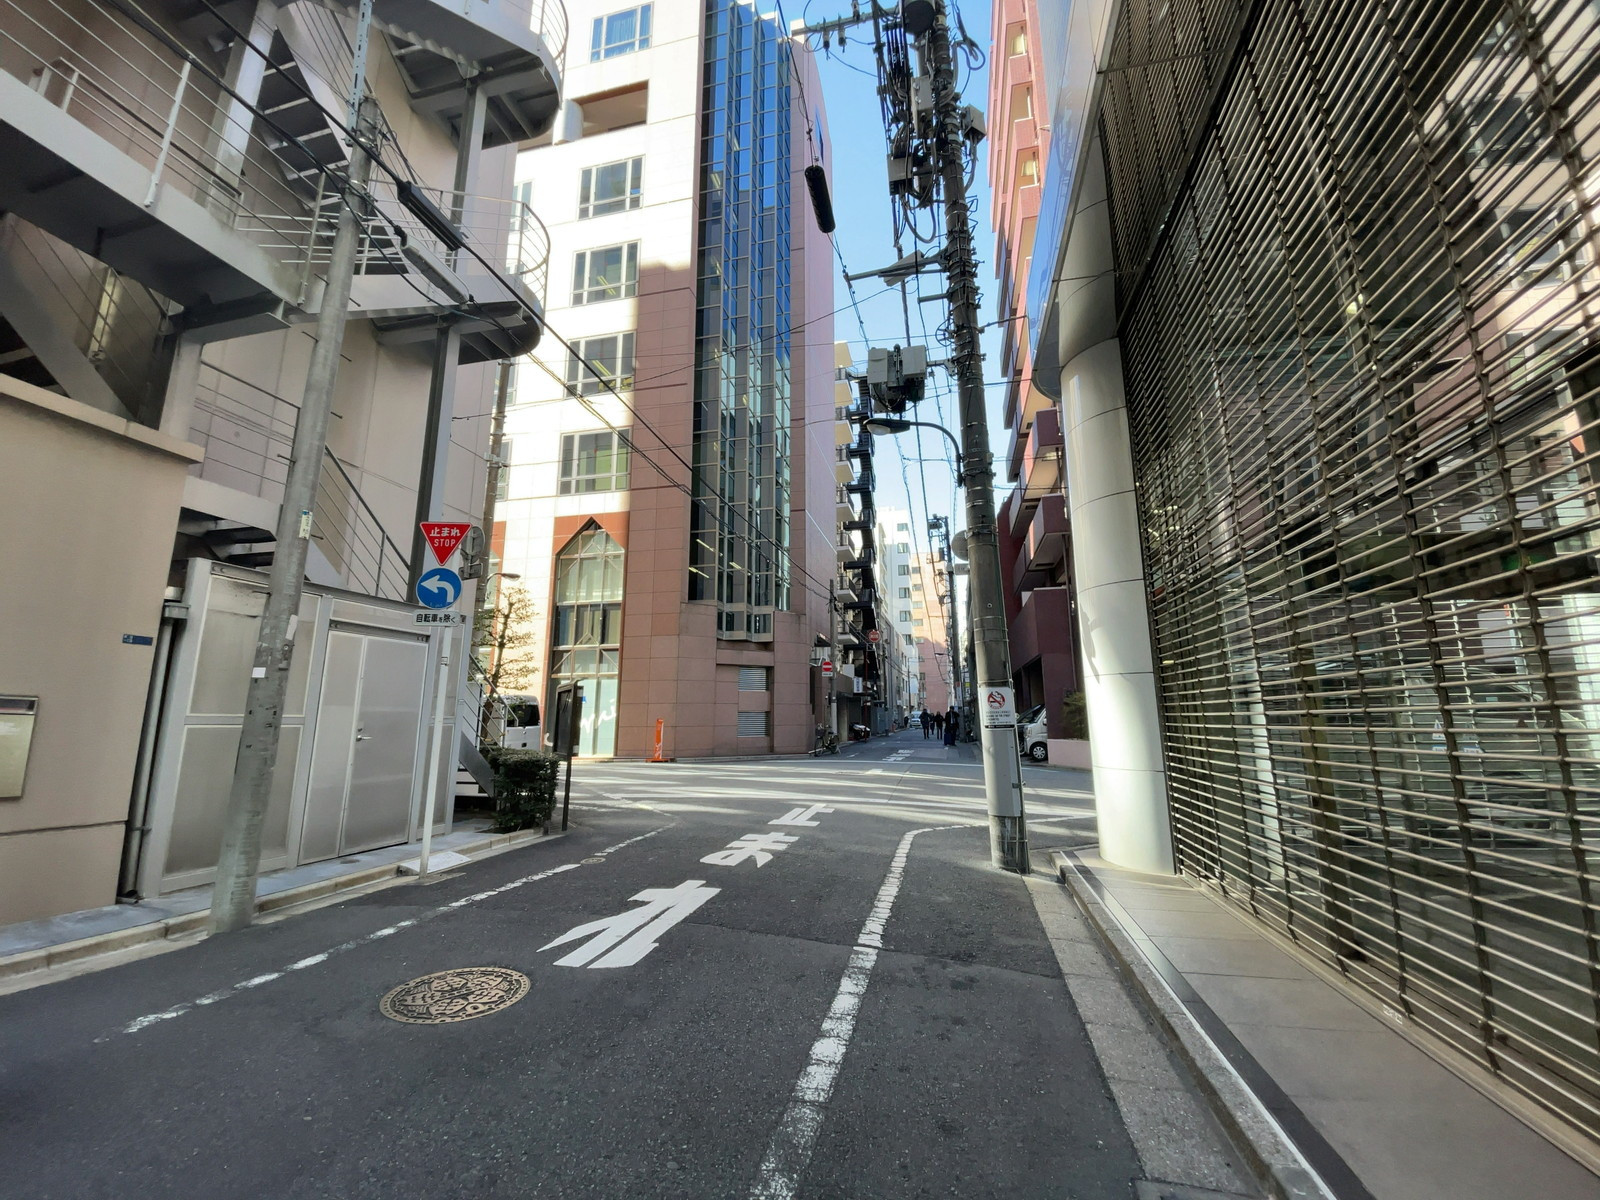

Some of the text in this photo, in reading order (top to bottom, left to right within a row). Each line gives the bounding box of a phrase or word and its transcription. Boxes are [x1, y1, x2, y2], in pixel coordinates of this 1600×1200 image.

[430, 526, 461, 537] 止まれ
[433, 538, 456, 547] STOP
